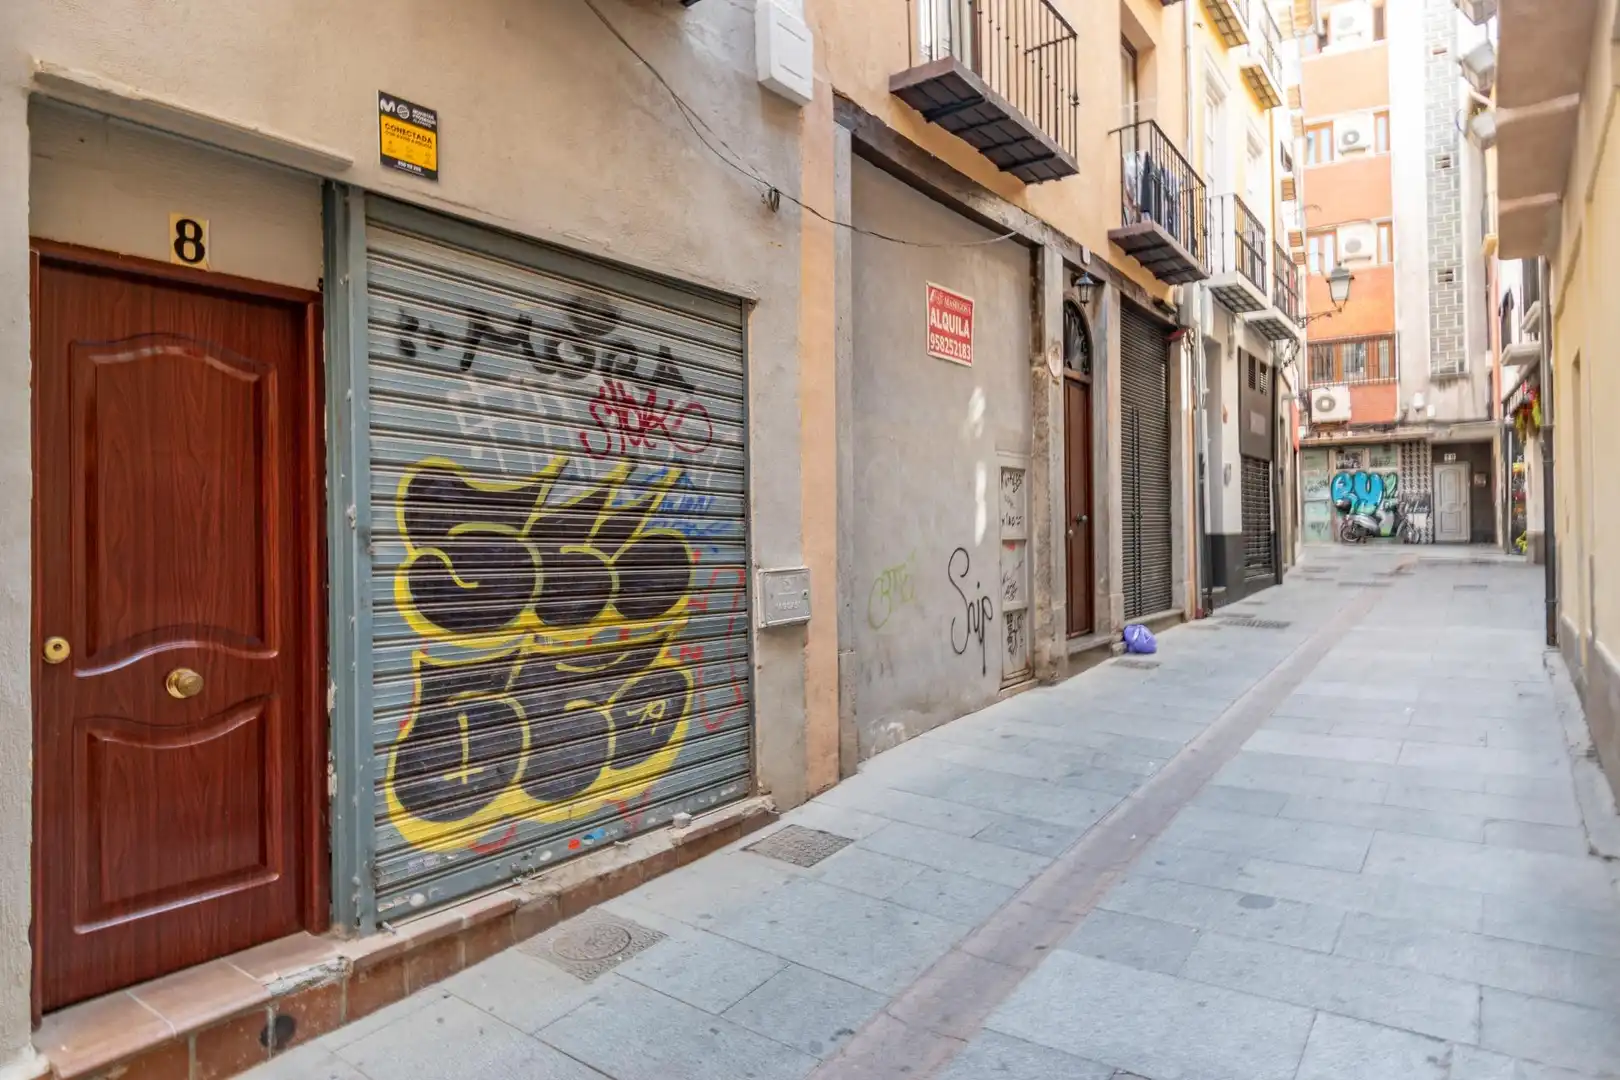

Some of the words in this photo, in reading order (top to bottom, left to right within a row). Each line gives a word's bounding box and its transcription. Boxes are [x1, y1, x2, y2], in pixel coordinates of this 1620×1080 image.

[384, 122, 433, 144] CONECTADA
[174, 218, 206, 263] 8
[930, 307, 970, 339] ALQUILA
